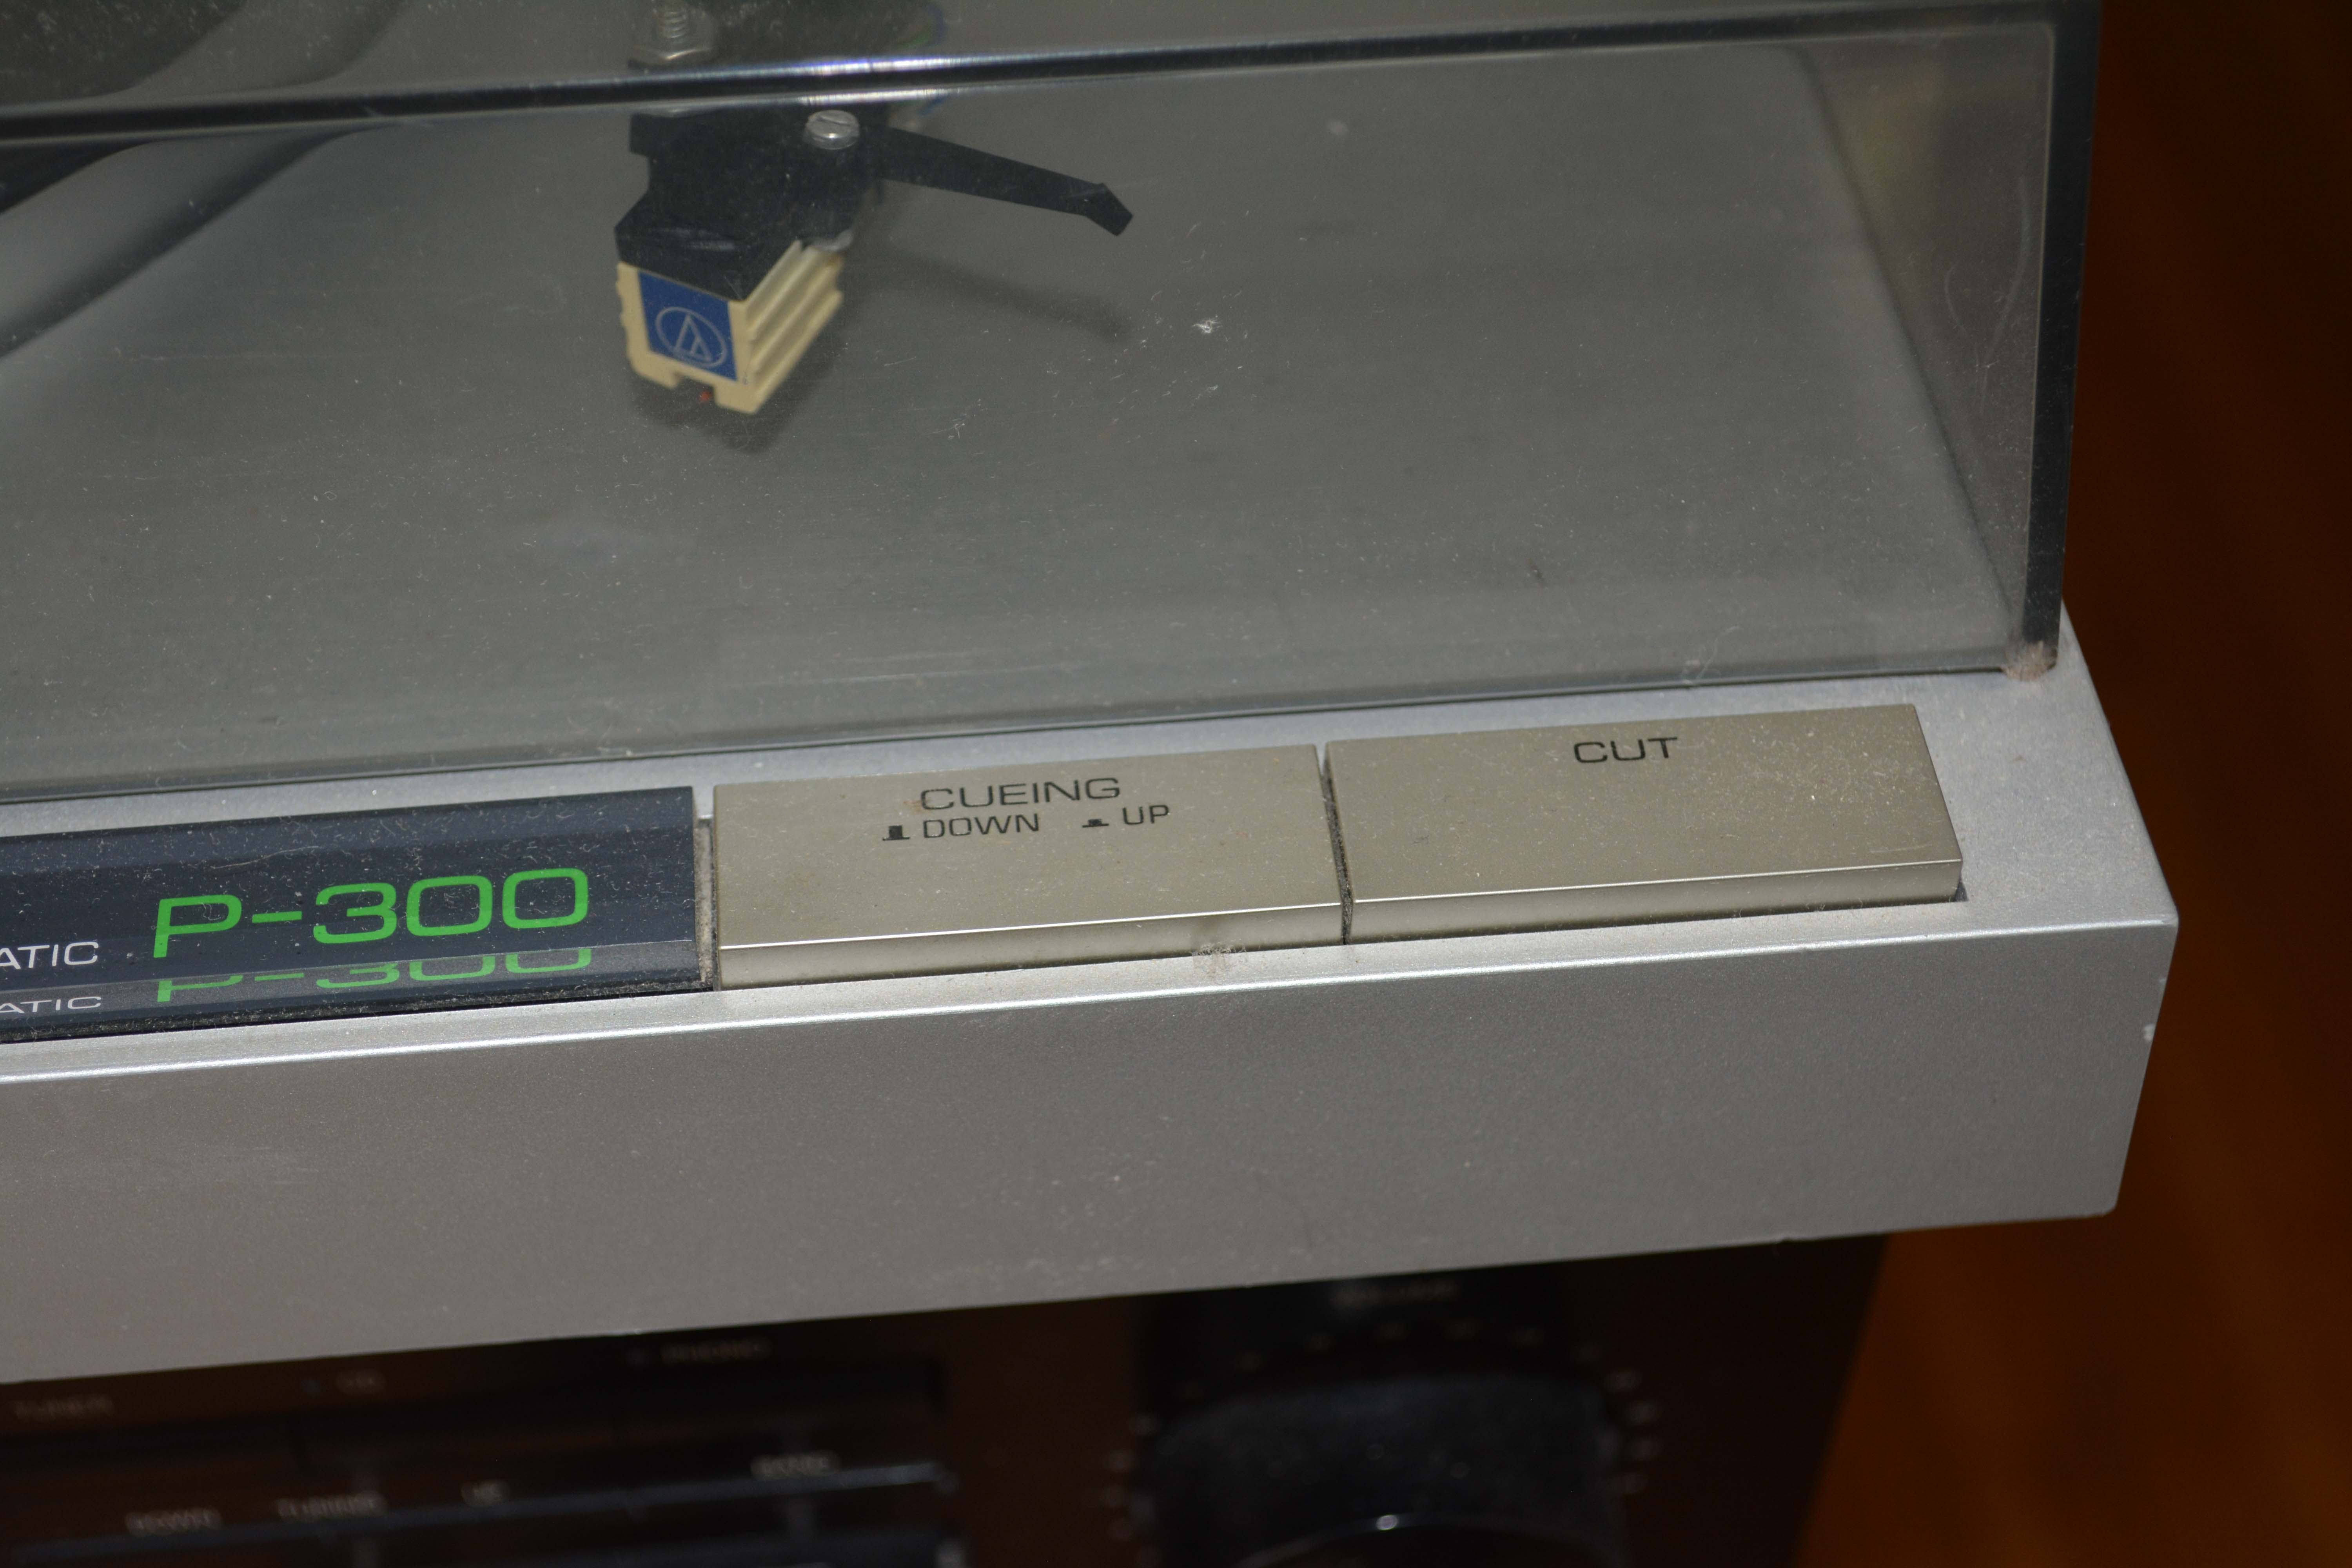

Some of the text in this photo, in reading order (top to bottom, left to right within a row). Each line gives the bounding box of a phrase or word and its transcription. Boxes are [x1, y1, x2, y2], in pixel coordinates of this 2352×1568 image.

[1573, 737, 1678, 763] CUT
[920, 777, 1121, 810] CUEING
[923, 804, 1170, 838] DOWN UP
[153, 867, 589, 958] P-300
